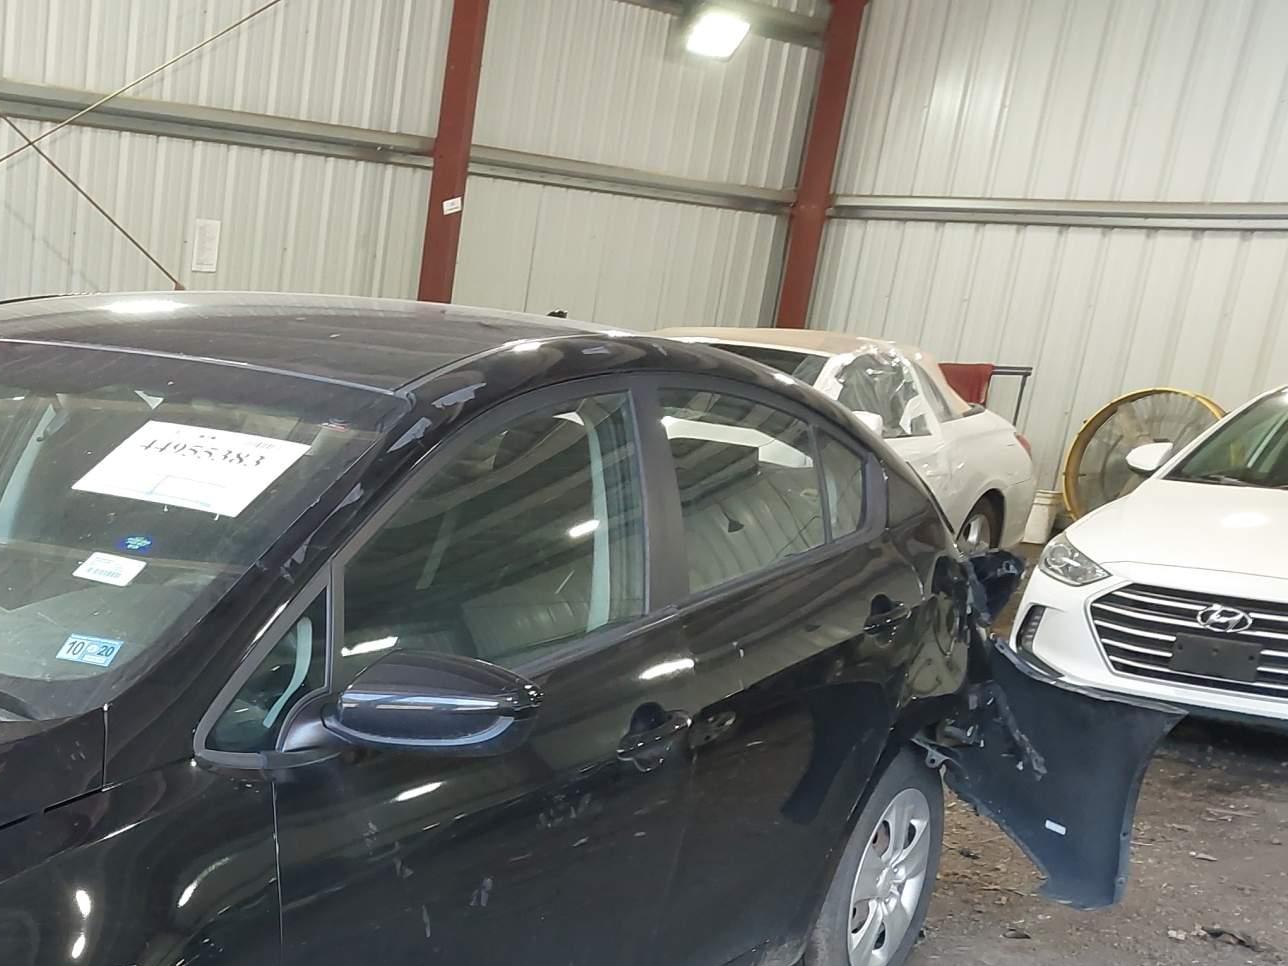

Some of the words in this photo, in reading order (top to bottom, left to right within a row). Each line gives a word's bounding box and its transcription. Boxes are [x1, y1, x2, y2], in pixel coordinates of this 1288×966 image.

[138, 438, 267, 468] 44955383
[66, 639, 86, 656] 10
[96, 645, 116, 658] 20
